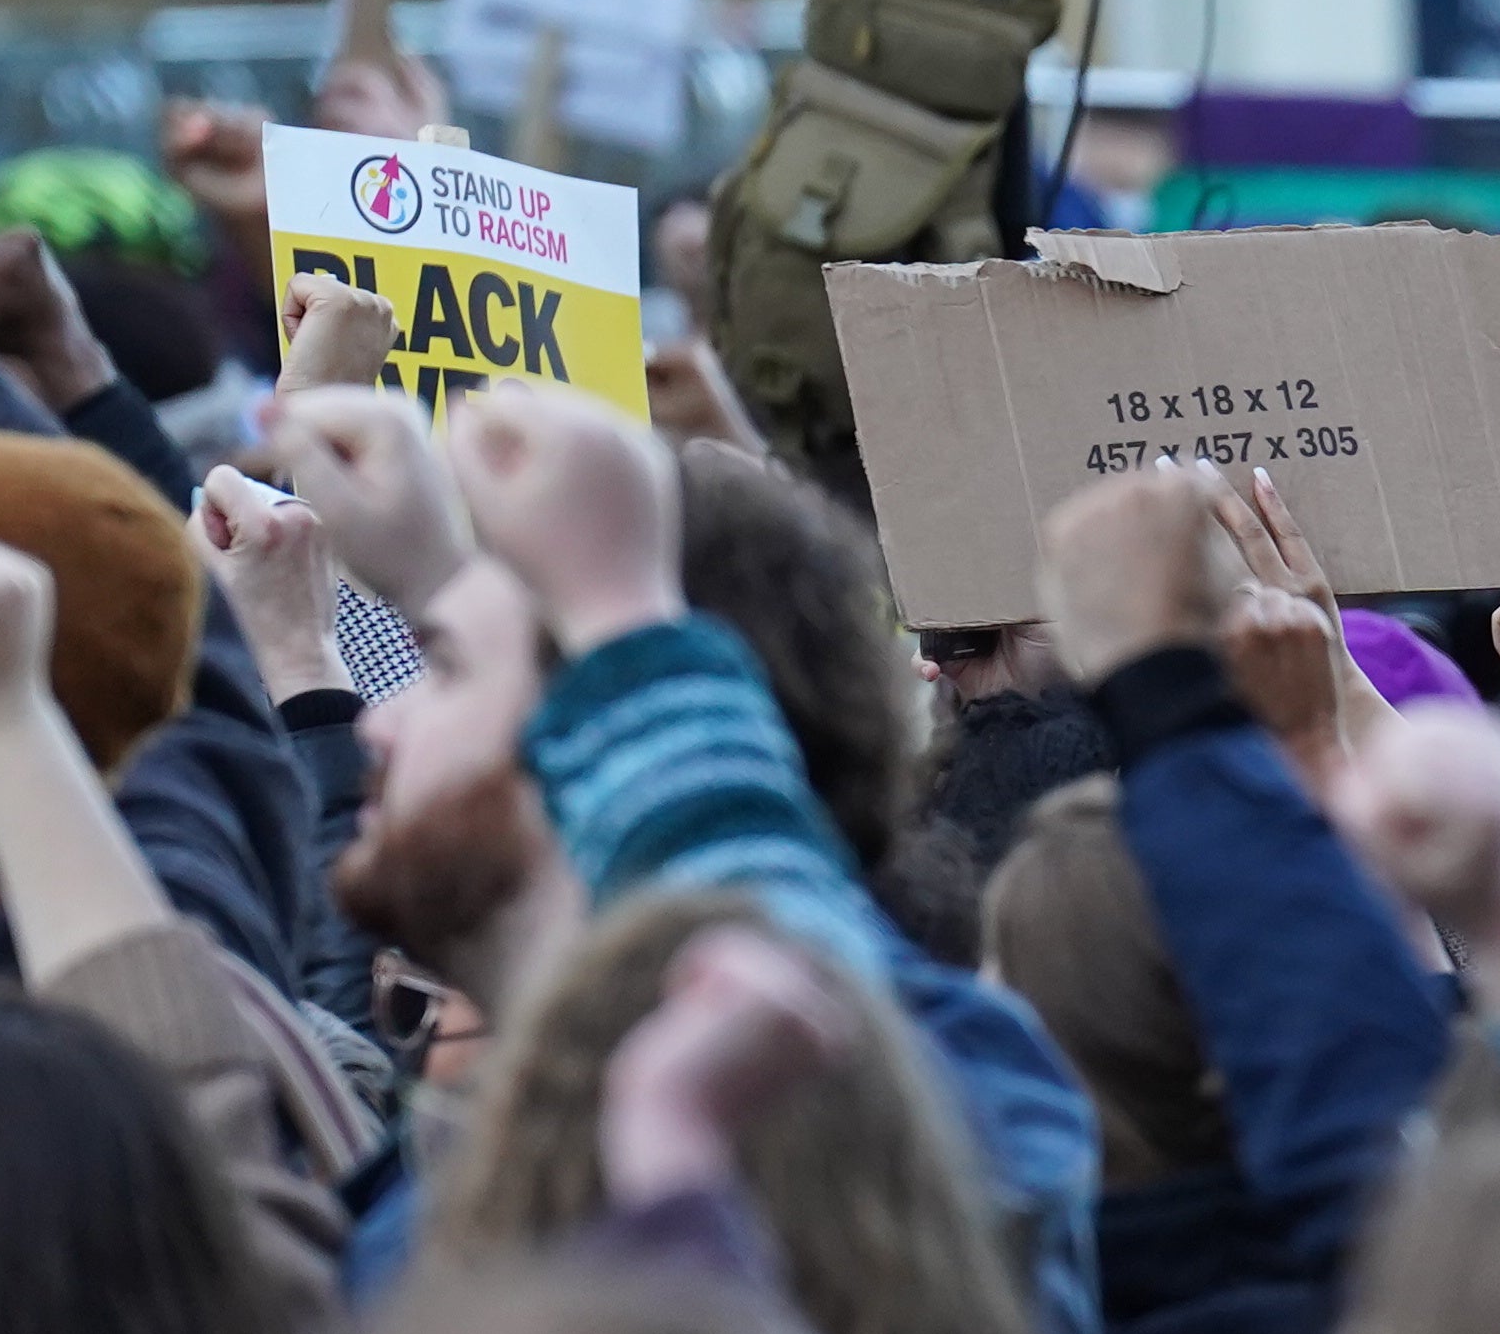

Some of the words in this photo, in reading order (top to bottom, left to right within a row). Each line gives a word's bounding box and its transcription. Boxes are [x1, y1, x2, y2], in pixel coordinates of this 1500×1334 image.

[431, 166, 513, 212] STAND
[519, 186, 551, 222] UP
[433, 201, 471, 238] TO
[478, 210, 568, 265] RACISM
[1107, 391, 1151, 423] 18
[1160, 395, 1184, 419] x
[1191, 384, 1235, 417] 18
[1243, 388, 1268, 413] x
[1276, 379, 1319, 410] 12
[1086, 441, 1148, 474] 457
[1194, 431, 1252, 465] 457
[1265, 435, 1289, 460] x
[1296, 426, 1359, 459] 305
